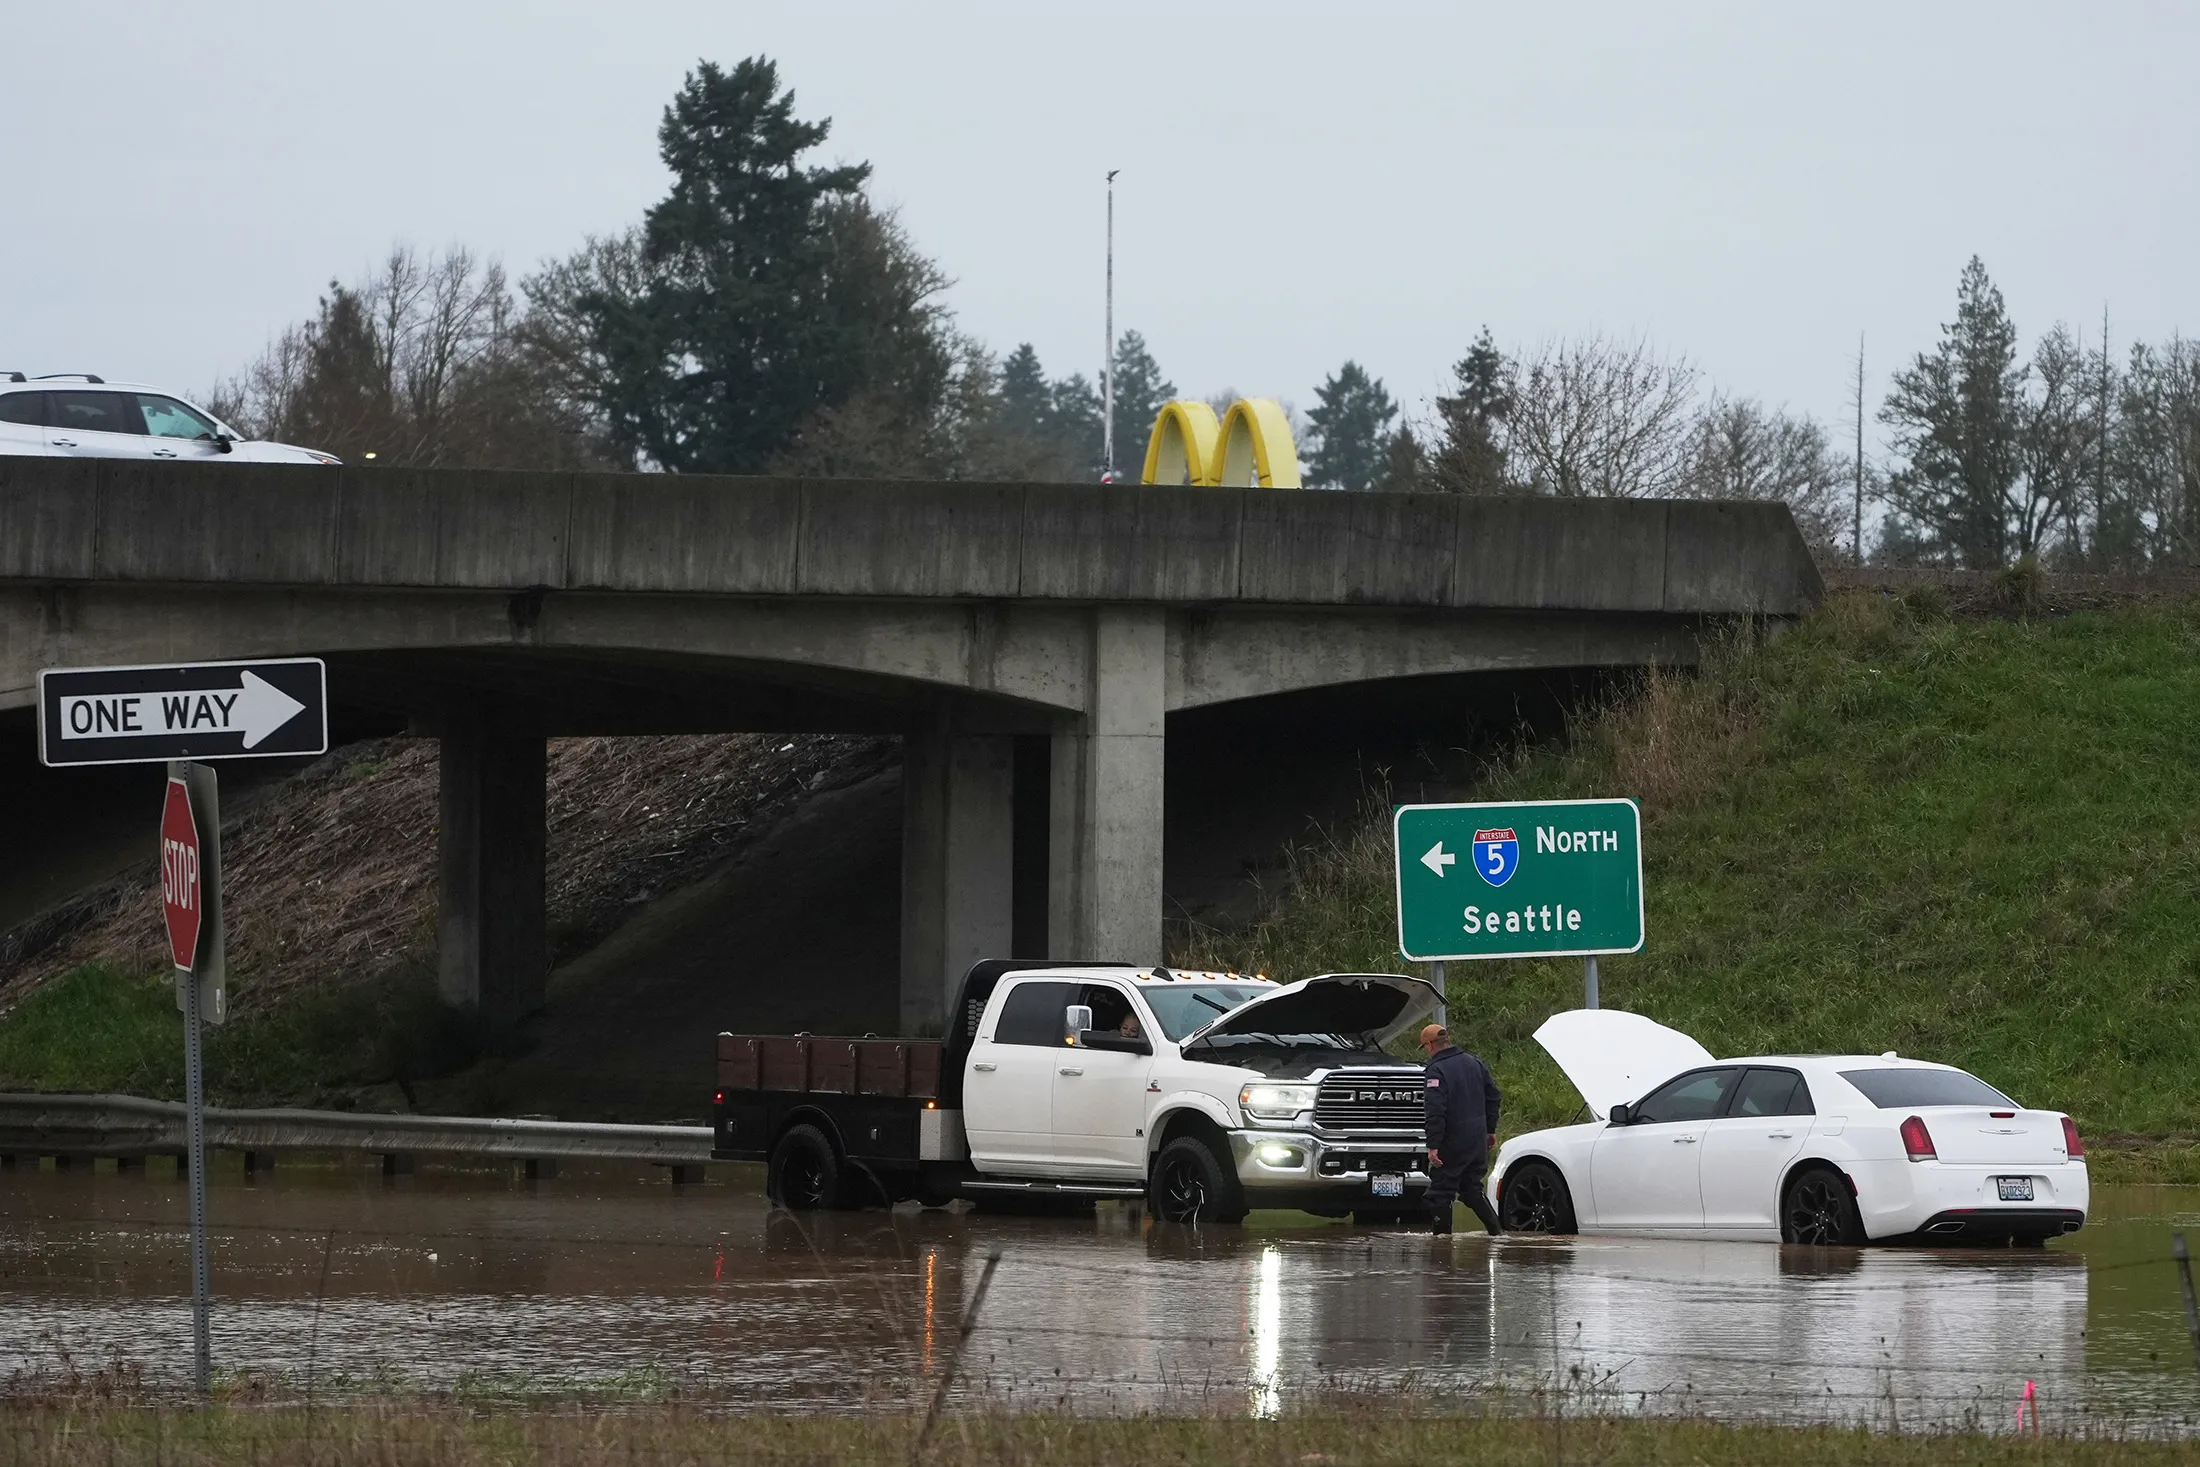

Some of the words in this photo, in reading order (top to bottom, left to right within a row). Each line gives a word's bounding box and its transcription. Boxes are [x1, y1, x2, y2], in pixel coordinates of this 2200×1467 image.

[70, 698, 142, 734] ONE
[162, 694, 238, 729] WAY
[1479, 831, 1510, 840] INTERSTATE
[1536, 826, 1618, 853] NORTH
[164, 838, 197, 910] STOP
[1487, 843, 1505, 875] 5
[1463, 904, 1581, 934] Seattle
[1359, 1091, 1411, 1101] RAM
